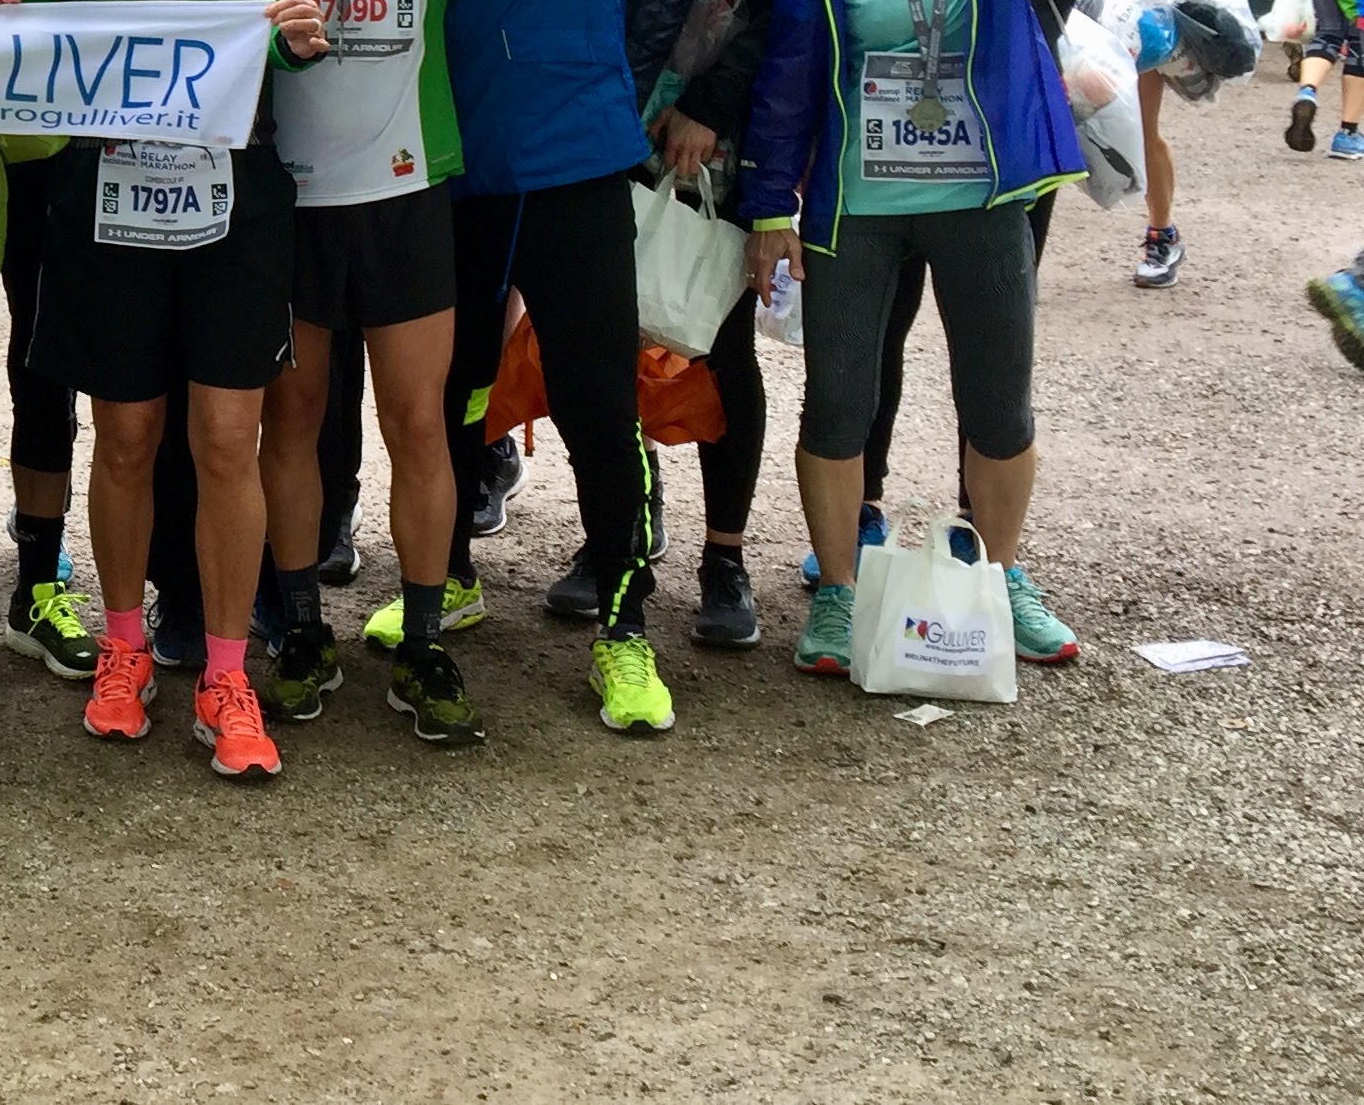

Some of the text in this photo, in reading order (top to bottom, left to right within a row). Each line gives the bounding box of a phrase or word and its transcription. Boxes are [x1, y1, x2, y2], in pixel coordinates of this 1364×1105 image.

[351, 44, 404, 53] ARMOUR
[140, 151, 178, 163] RELAY
[140, 161, 196, 171] MARATHON
[889, 166, 989, 175] UNDER ARMOUR
[130, 184, 202, 215] 1797A
[123, 227, 218, 242] UNDER ARMOUR
